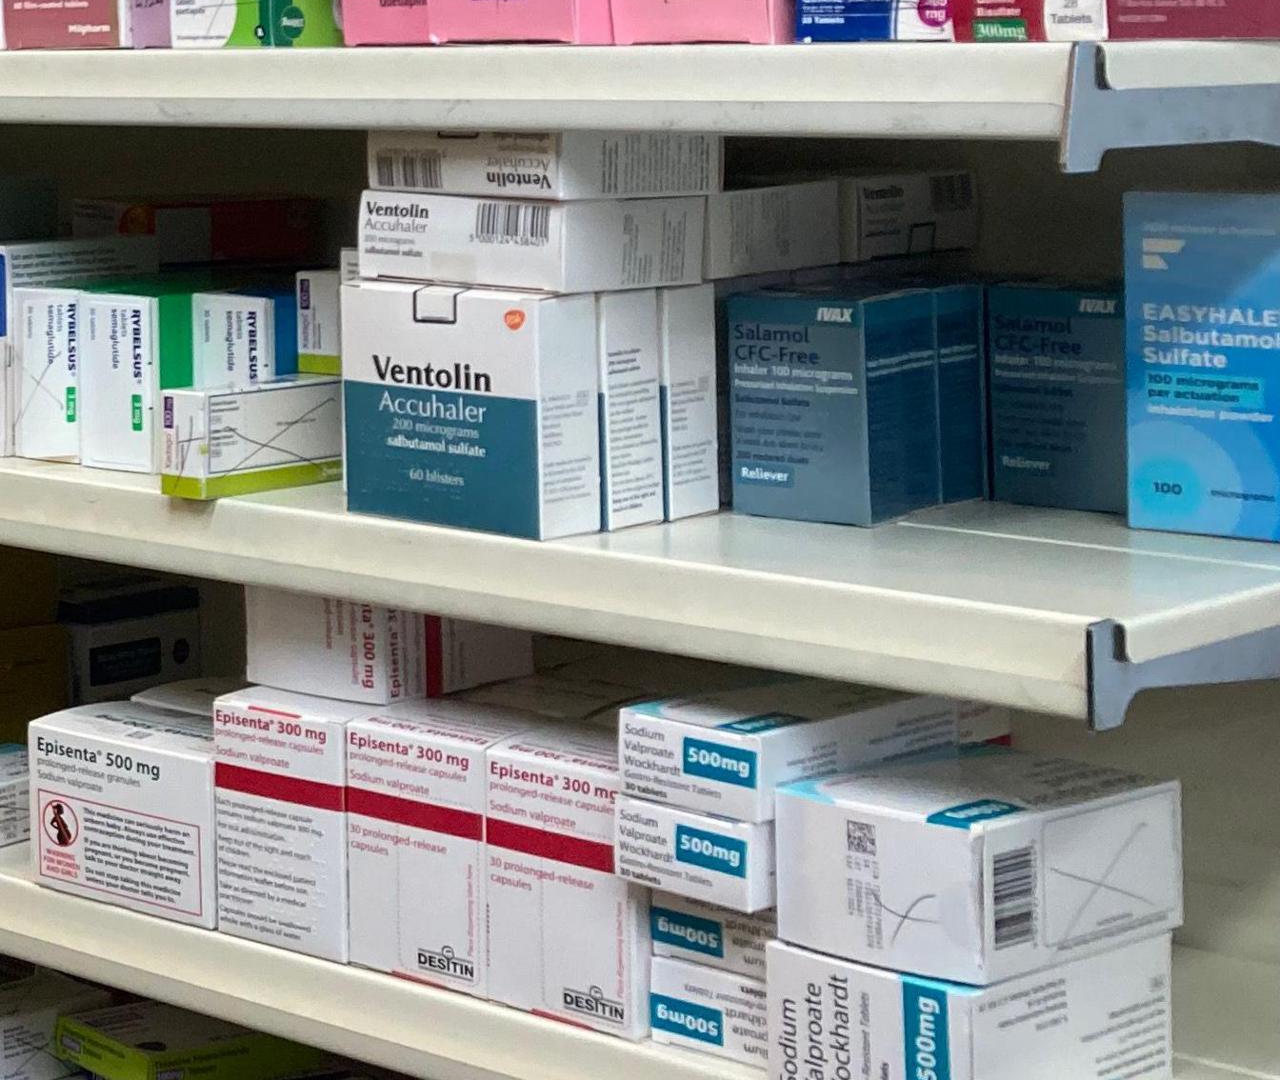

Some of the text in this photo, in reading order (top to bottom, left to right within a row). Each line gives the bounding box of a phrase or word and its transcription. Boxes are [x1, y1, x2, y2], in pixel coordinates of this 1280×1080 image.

[1051, 13, 1092, 24] Tablets
[487, 171, 551, 189] Ventolin
[366, 201, 429, 219] Ventolin
[364, 218, 428, 234] Accuhaler
[817, 307, 854, 323] IVAX
[1079, 298, 1117, 314] IVAX
[111, 308, 119, 370] semaglutide
[226, 310, 235, 372] semaglutide
[734, 324, 809, 343] Salamol
[246, 310, 258, 382] RYBELSUS
[735, 346, 820, 365] CFC-Free
[1143, 348, 1228, 368] Sulfate
[372, 354, 491, 392] Ventolin
[1148, 373, 1259, 392] 100 micrograms
[1174, 389, 1240, 402] actuation
[379, 390, 487, 424] Accuhaler
[393, 419, 479, 440] 200 micrograms
[387, 435, 486, 458] salbutamol sulfate
[1002, 456, 1050, 470] Reliever
[410, 467, 464, 486] 60 blisters
[741, 467, 788, 482] Reliever
[1153, 481, 1182, 494] 100
[624, 723, 665, 742] Sodium
[624, 740, 675, 759] Valproate
[37, 757, 141, 788] prolonged-release granules
[350, 751, 467, 782] prolonged-release capsules
[624, 756, 681, 777] Wockhardt
[687, 747, 750, 778] 500mg
[37, 770, 103, 793] Sodium valproate
[619, 809, 659, 829] Sodium
[350, 823, 447, 854] 30 prolonged-release
[619, 825, 668, 846] Valproate
[350, 839, 389, 856] capsules
[679, 834, 741, 868] 500mg
[490, 871, 532, 891] capsules
[657, 916, 720, 949] 500mg
[417, 952, 474, 978] DESITIN
[563, 991, 624, 1020] DESITIN
[656, 1002, 719, 1037] 500mg
